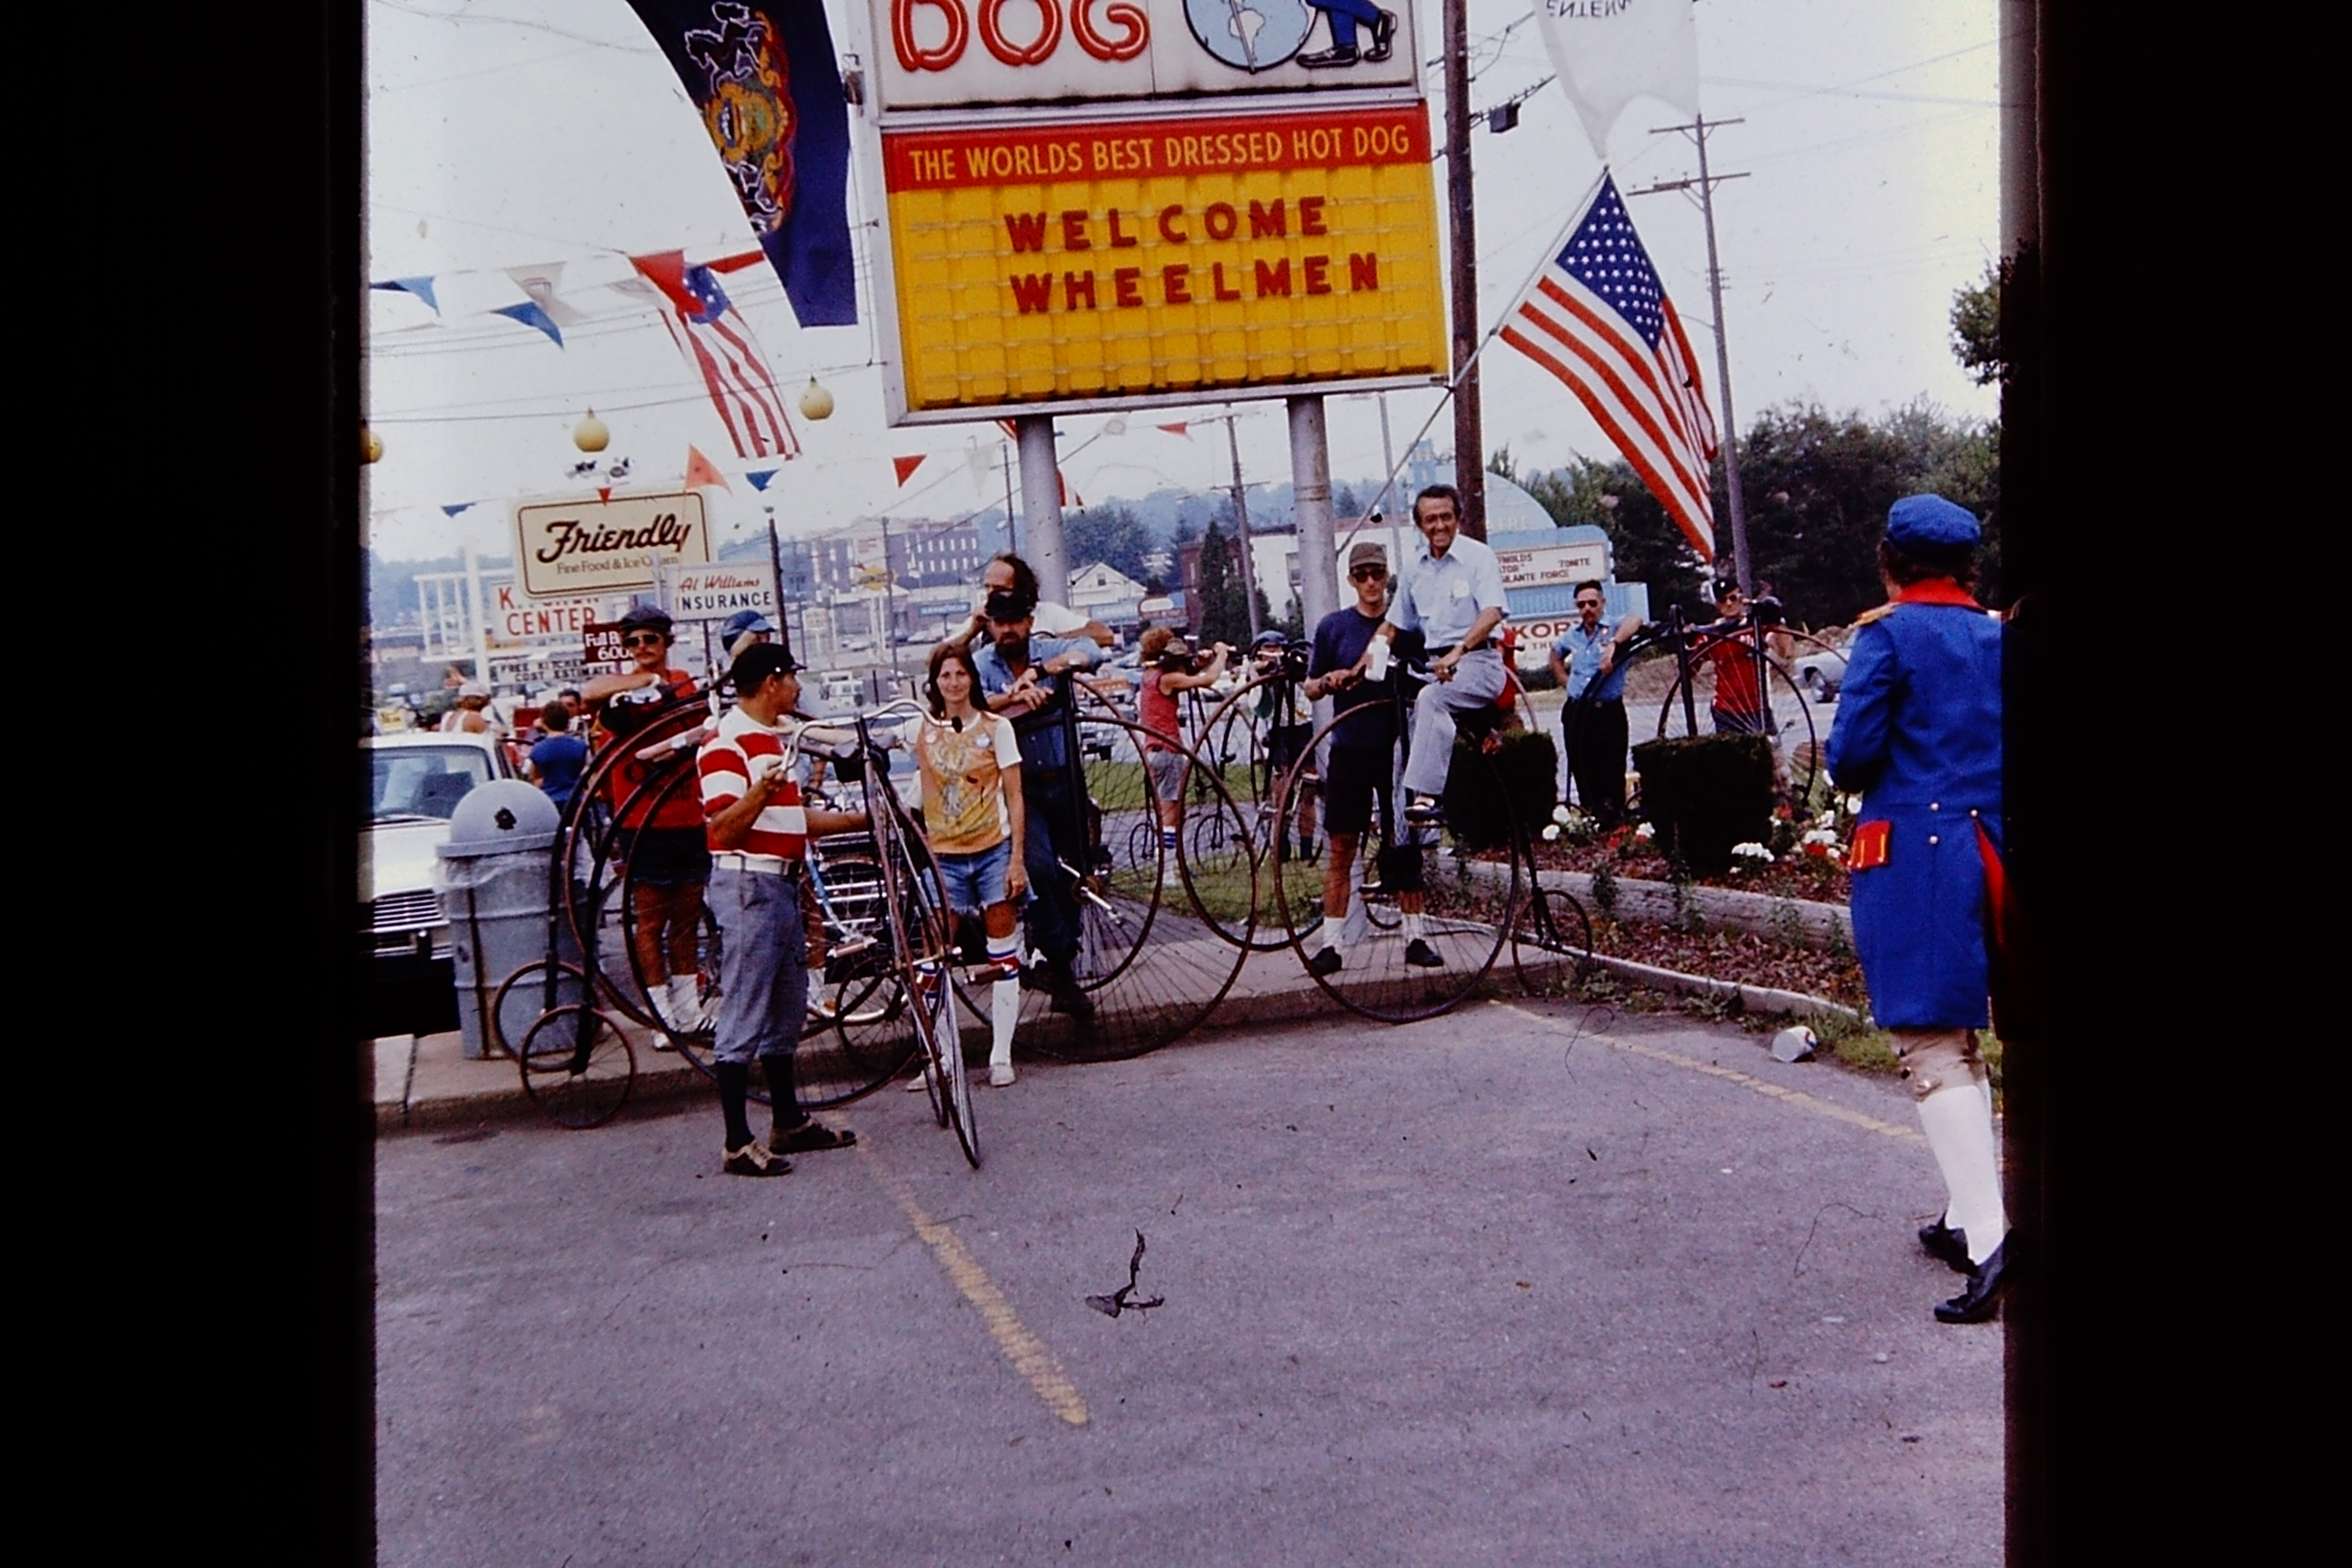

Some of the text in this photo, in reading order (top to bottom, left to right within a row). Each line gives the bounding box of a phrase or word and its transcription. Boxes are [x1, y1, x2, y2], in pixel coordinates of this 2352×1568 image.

[891, 0, 1150, 72] DOG
[909, 124, 1410, 181] THE WORLDS BEST DRESSED HOT DOG
[1004, 196, 1328, 253] WELCOME
[1010, 252, 1378, 314] WHEELMEN
[536, 513, 692, 563] Friendly
[557, 562, 580, 574] Fine
[581, 560, 610, 572] Food
[612, 558, 622, 570] &
[623, 557, 640, 568] Ice
[1559, 558, 1590, 567] TONITE
[679, 575, 760, 592] Al Williams
[1540, 569, 1569, 579] FORCE
[675, 591, 771, 611] INSURANCE
[507, 607, 595, 636] CENTER
[500, 663, 529, 673] FREE
[515, 666, 611, 682] COST ESTIMATE
